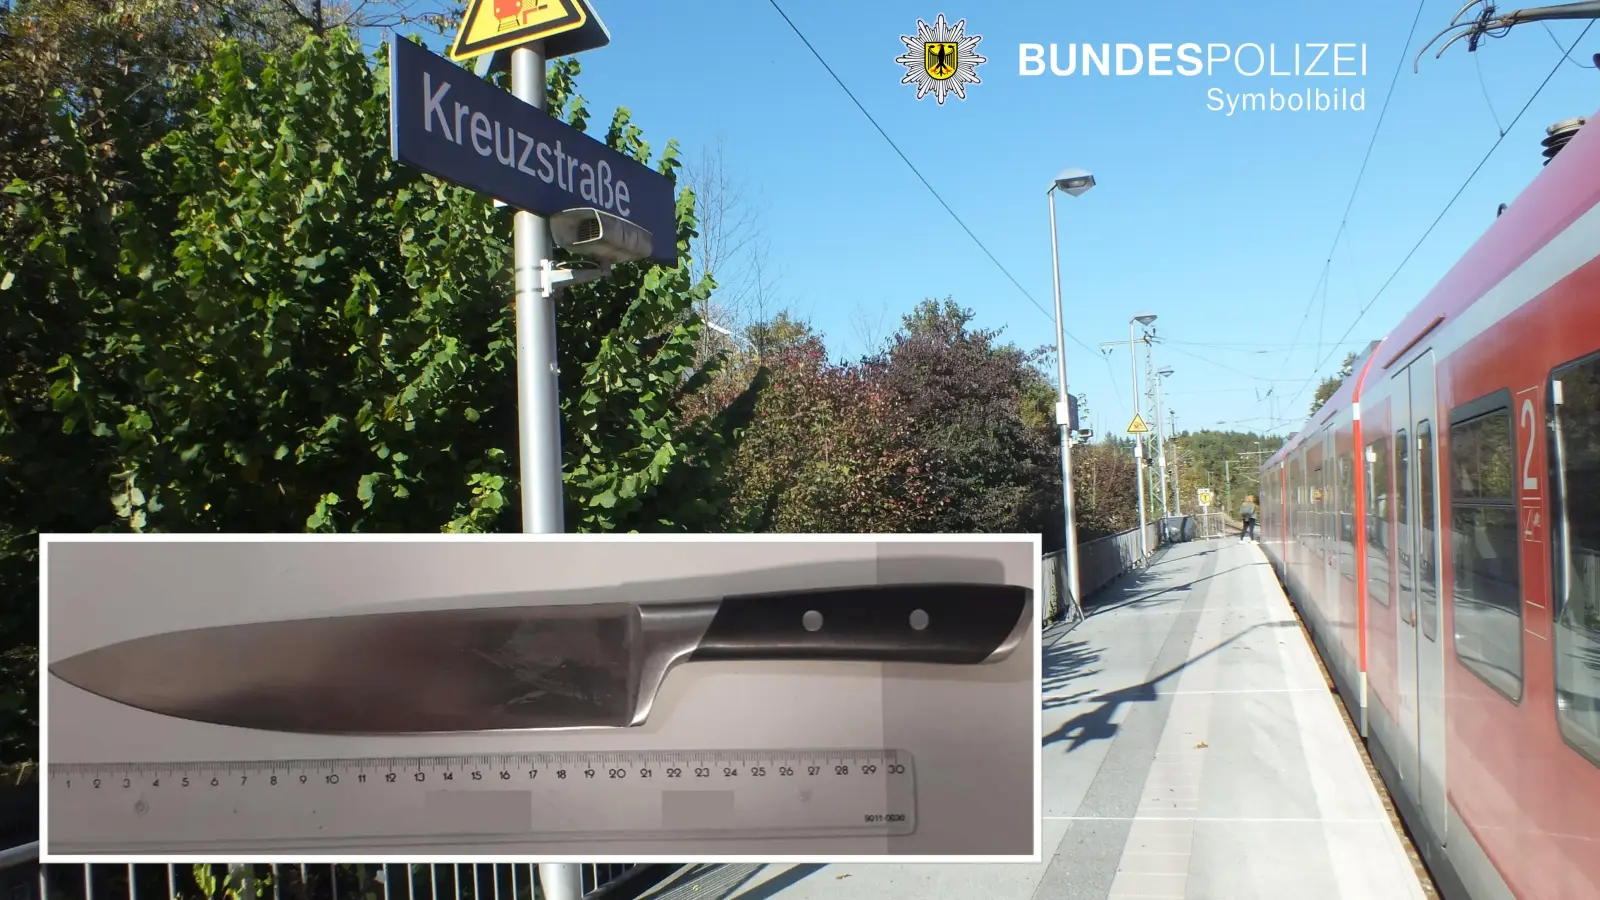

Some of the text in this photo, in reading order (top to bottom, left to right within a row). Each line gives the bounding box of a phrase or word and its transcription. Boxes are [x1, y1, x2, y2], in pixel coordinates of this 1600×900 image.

[422, 71, 631, 217] Kreuzstraße
[1521, 399, 1537, 489] 2
[66, 765, 905, 789] 1 2 3 4 5 6 7 8 9 10 11 12 13 14 15 16 17 18 19 20 21 22 23 24 25 26 27 28 29 30
